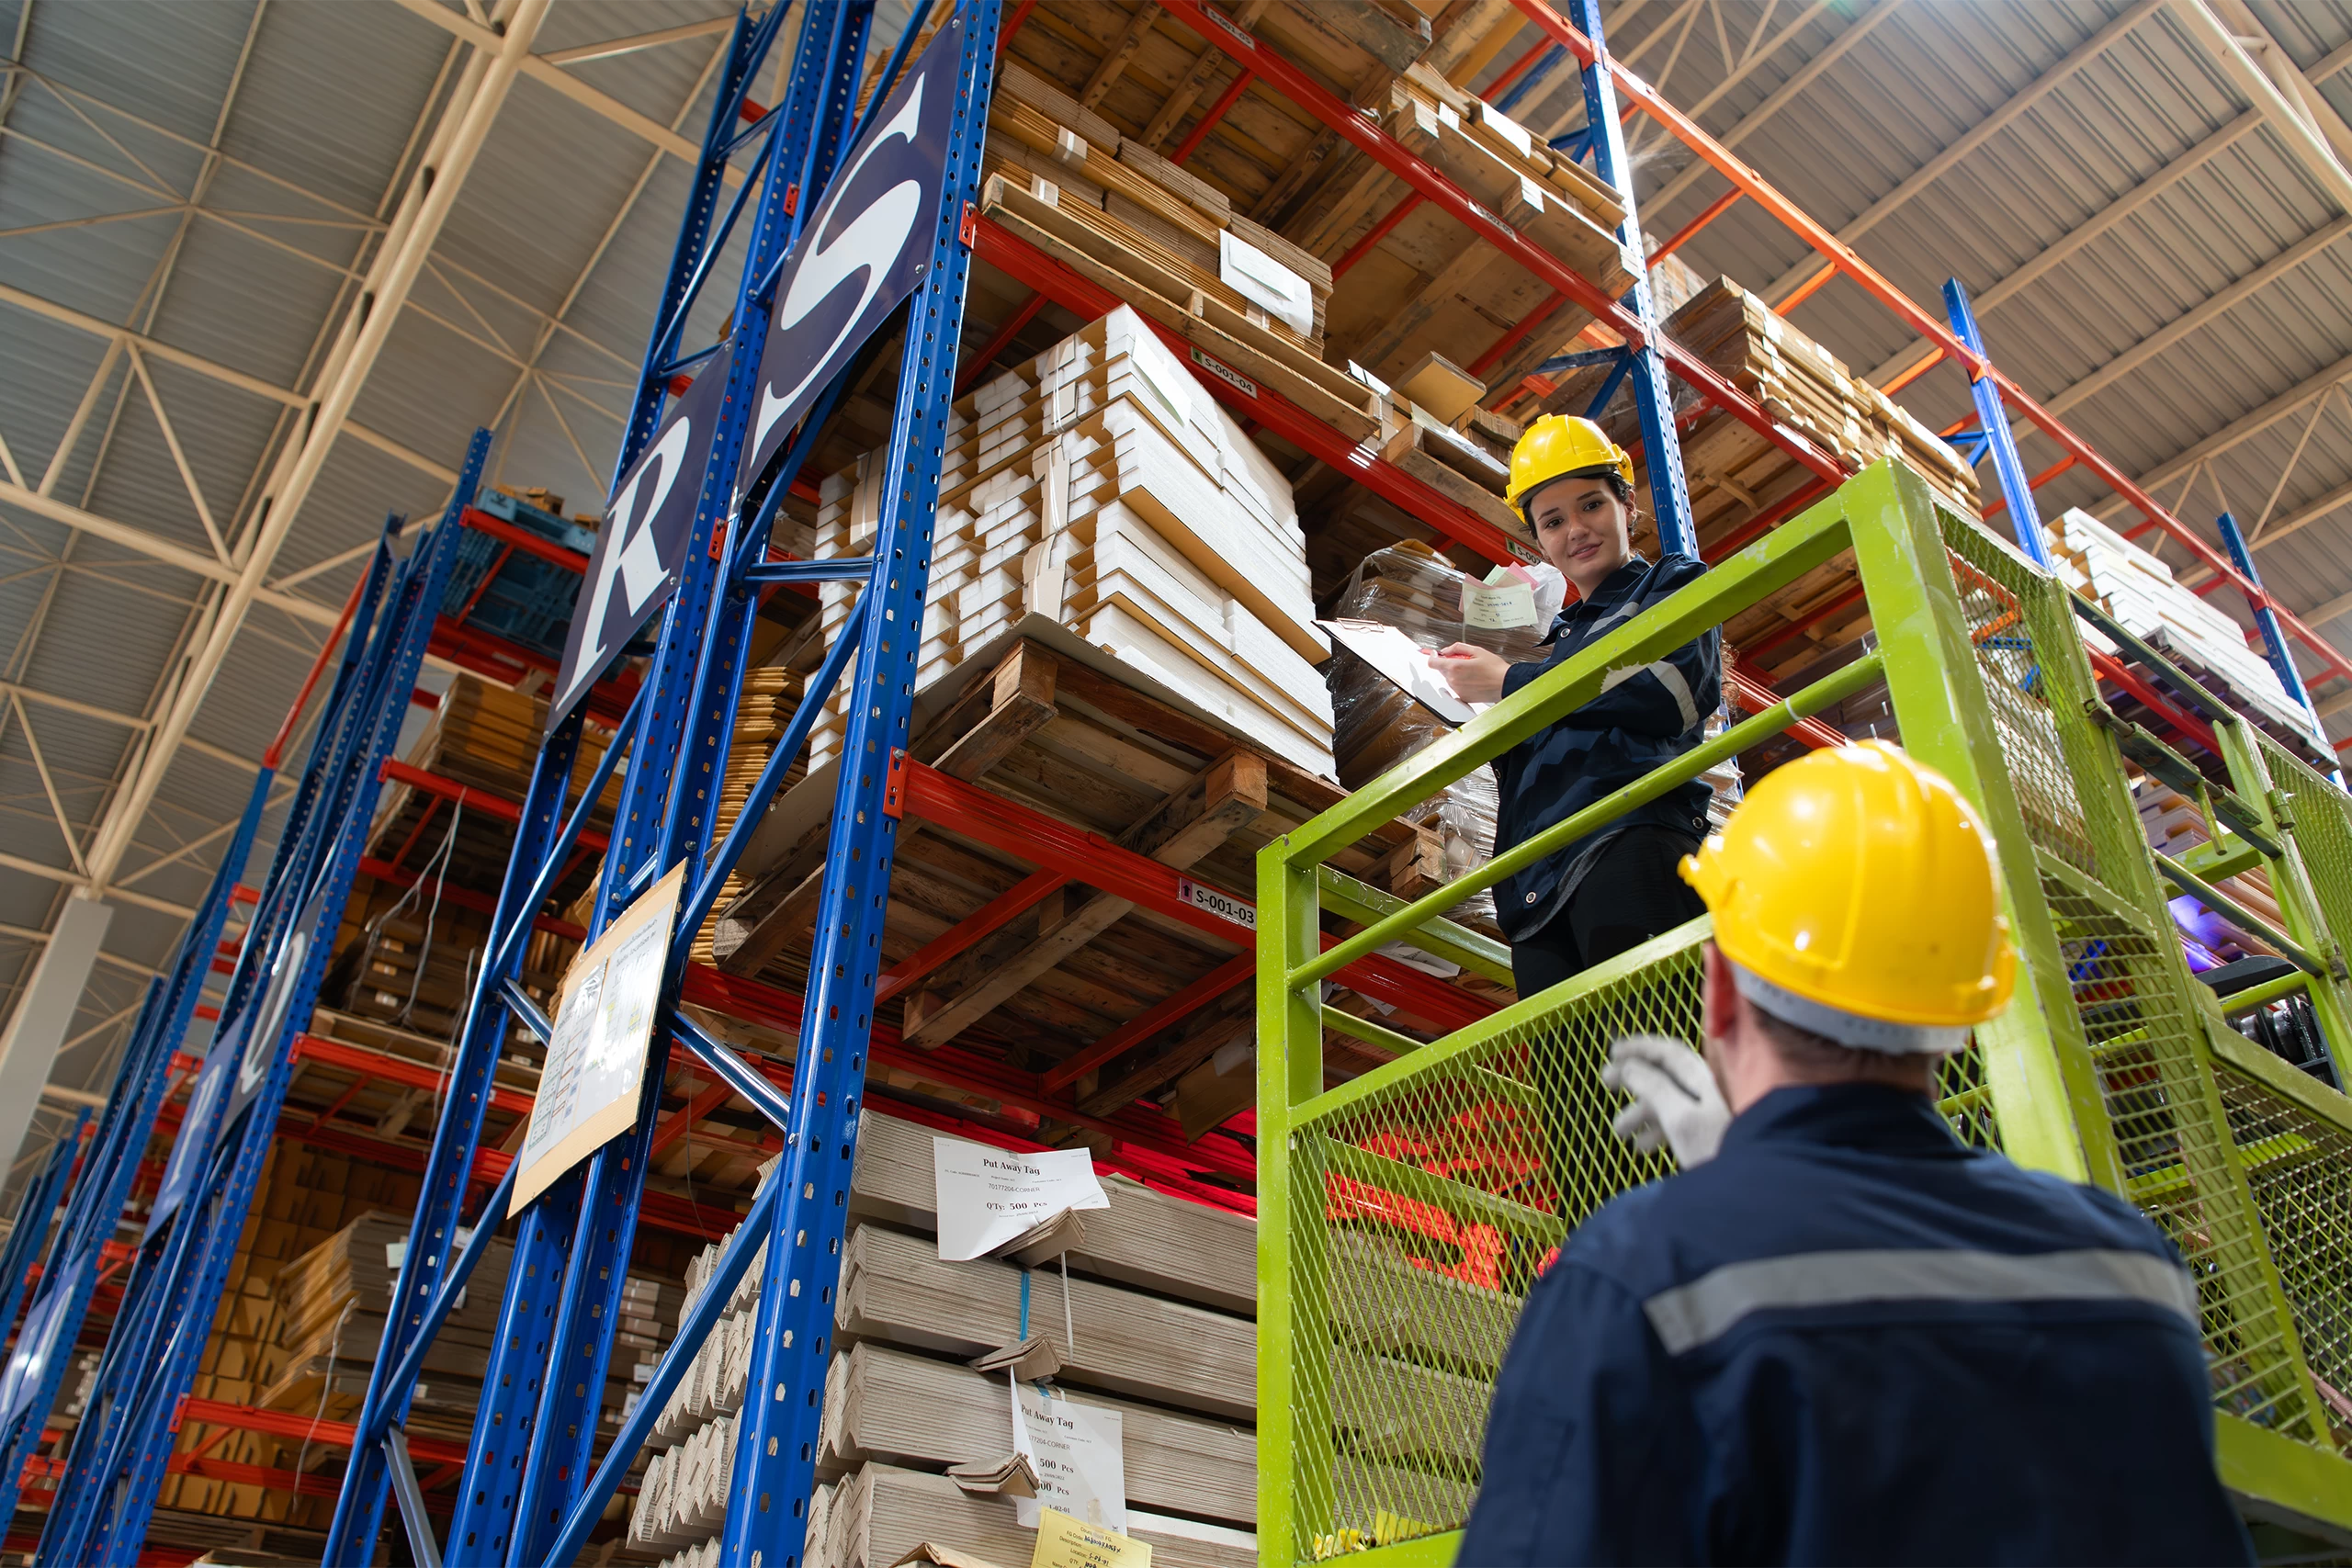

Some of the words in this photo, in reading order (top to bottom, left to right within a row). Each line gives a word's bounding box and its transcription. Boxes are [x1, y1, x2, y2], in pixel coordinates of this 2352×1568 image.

[751, 71, 925, 468] S
[1204, 358, 1252, 392] S-001-04
[556, 416, 690, 712] R
[1196, 890, 1254, 924] S-001-03
[983, 1158, 998, 1168] Put
[1000, 1161, 1022, 1174] Away
[1023, 1164, 1041, 1176] Tag
[988, 1182, 1040, 1193] 70177204-CORNER
[1009, 1202, 1028, 1211] 500
[1021, 1403, 1033, 1417] Put
[1034, 1410, 1056, 1427] Away
[1057, 1416, 1074, 1430] Tag
[1028, 1434, 1071, 1450] 177204-CORNER
[1039, 1458, 1057, 1470] 500
[1061, 1464, 1074, 1473] Pcs
[1040, 1482, 1052, 1492] 00
[1057, 1486, 1069, 1495] Pcs
